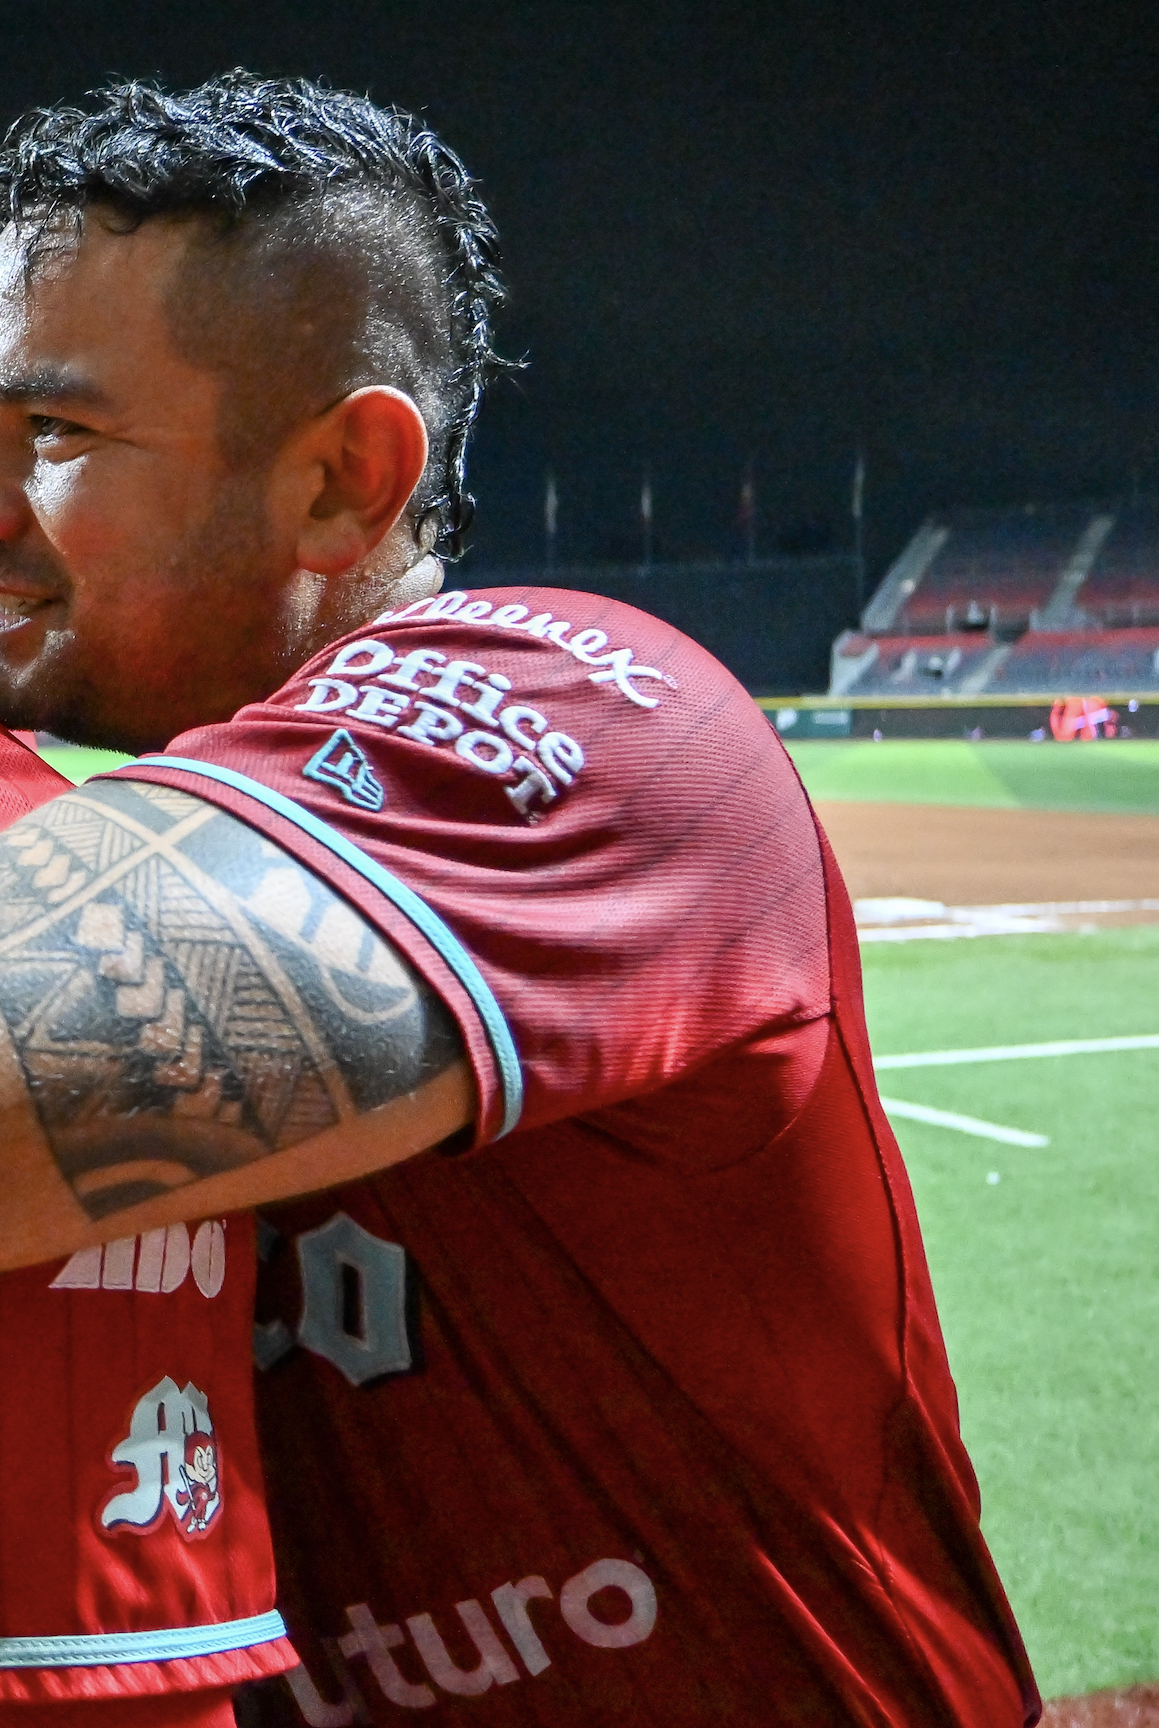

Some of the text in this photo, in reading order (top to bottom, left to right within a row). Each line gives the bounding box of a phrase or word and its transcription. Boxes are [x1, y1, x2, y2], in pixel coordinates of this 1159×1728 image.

[294, 677, 557, 815] DEPOT
[327, 639, 585, 786] Office
[266, 1558, 658, 1728] uturo
